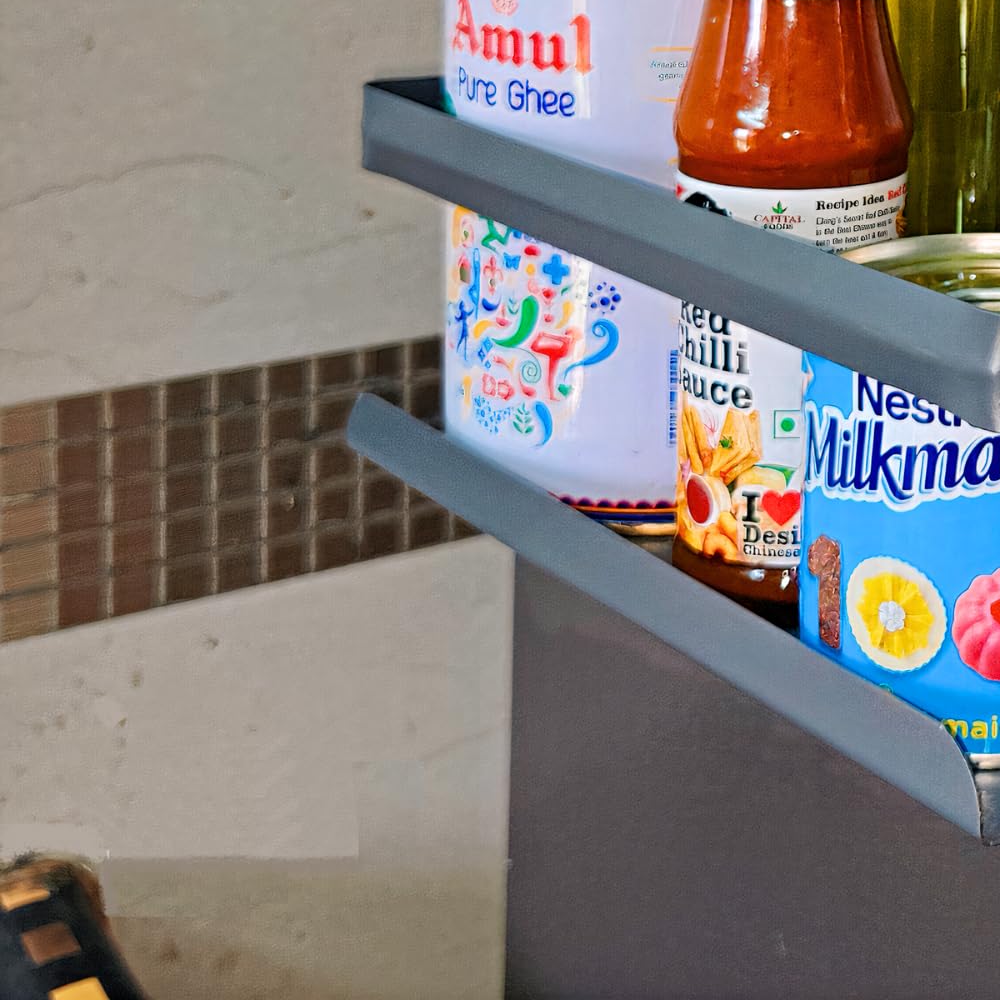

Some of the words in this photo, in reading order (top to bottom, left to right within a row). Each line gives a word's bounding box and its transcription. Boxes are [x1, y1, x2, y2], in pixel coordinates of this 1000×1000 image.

[459, 66, 497, 106] Pure
[508, 79, 576, 117] Ghee
[816, 198, 859, 211] Recipe
[862, 194, 885, 206] Idea
[679, 368, 753, 409] auce
[742, 491, 760, 522] I
[743, 525, 800, 545] Desi
